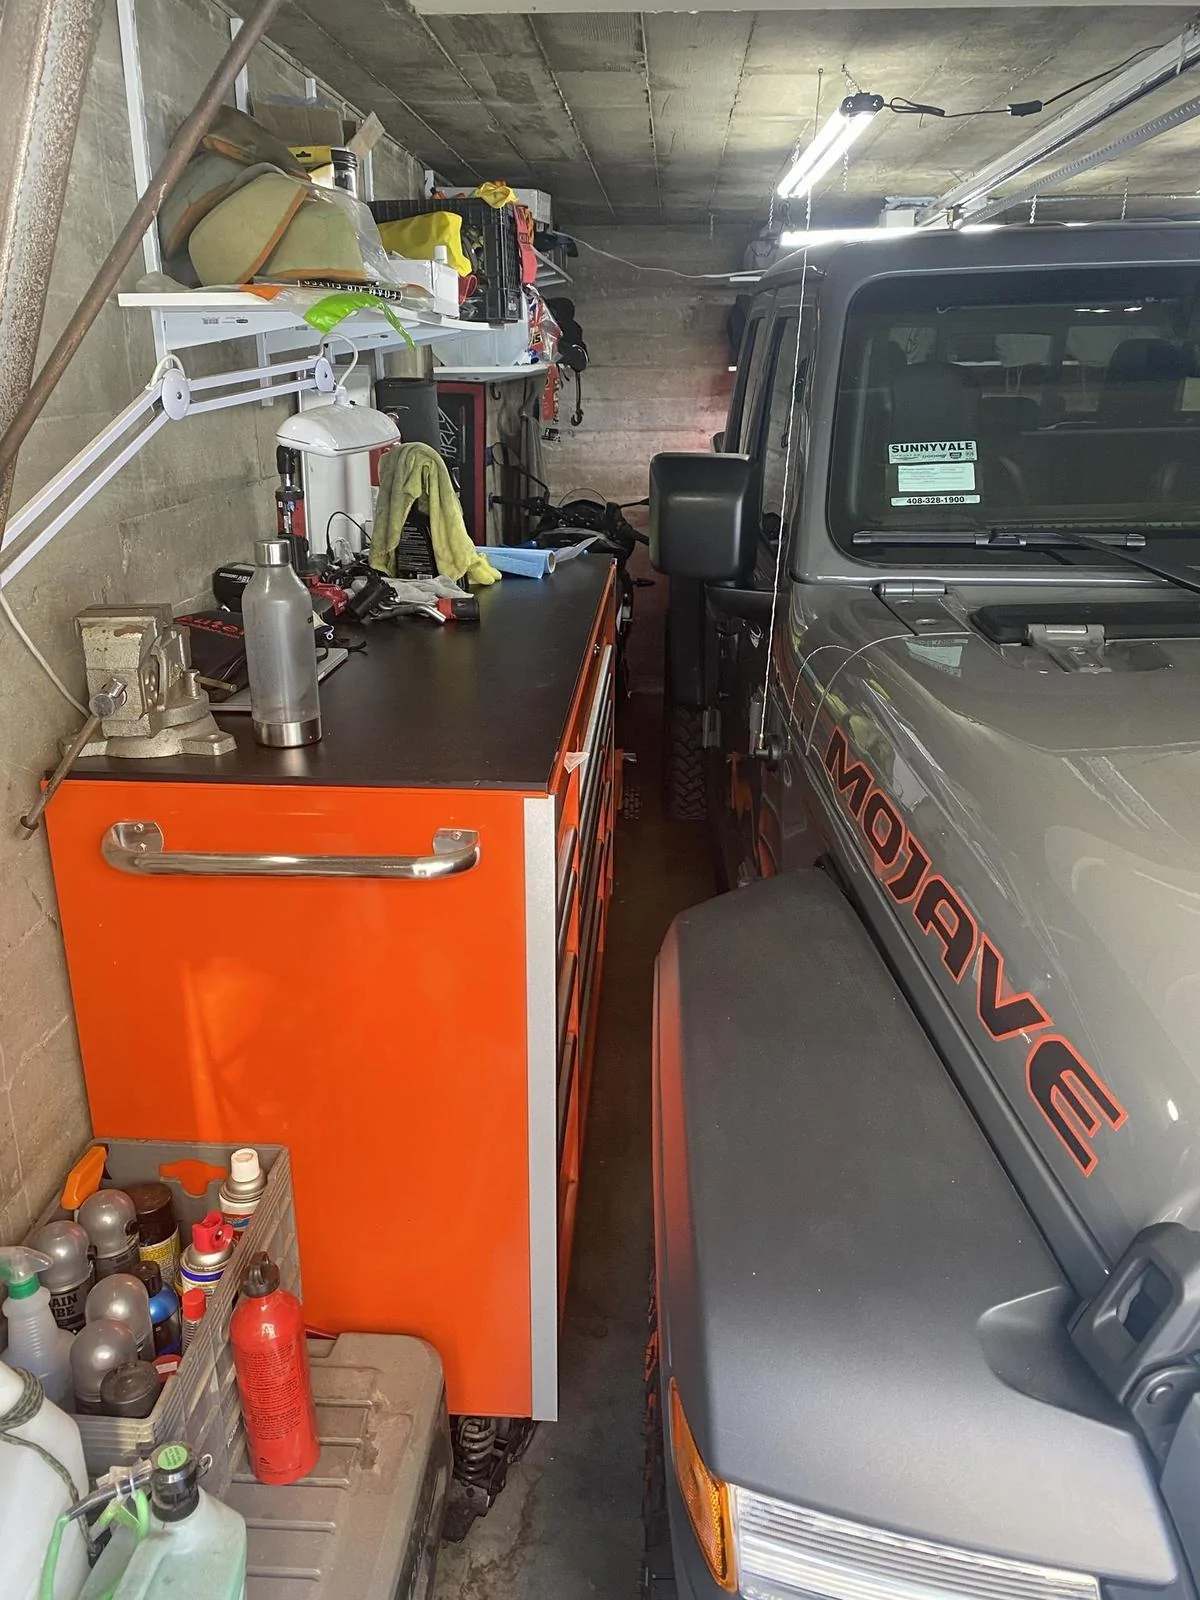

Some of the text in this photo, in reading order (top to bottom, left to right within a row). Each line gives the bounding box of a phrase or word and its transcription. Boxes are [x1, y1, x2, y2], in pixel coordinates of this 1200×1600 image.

[891, 442, 973, 454] SUNNYVALE
[906, 496, 965, 505] 408-328-1900
[824, 723, 1129, 1179] MOJAVE
[50, 1293, 78, 1308] AIN
